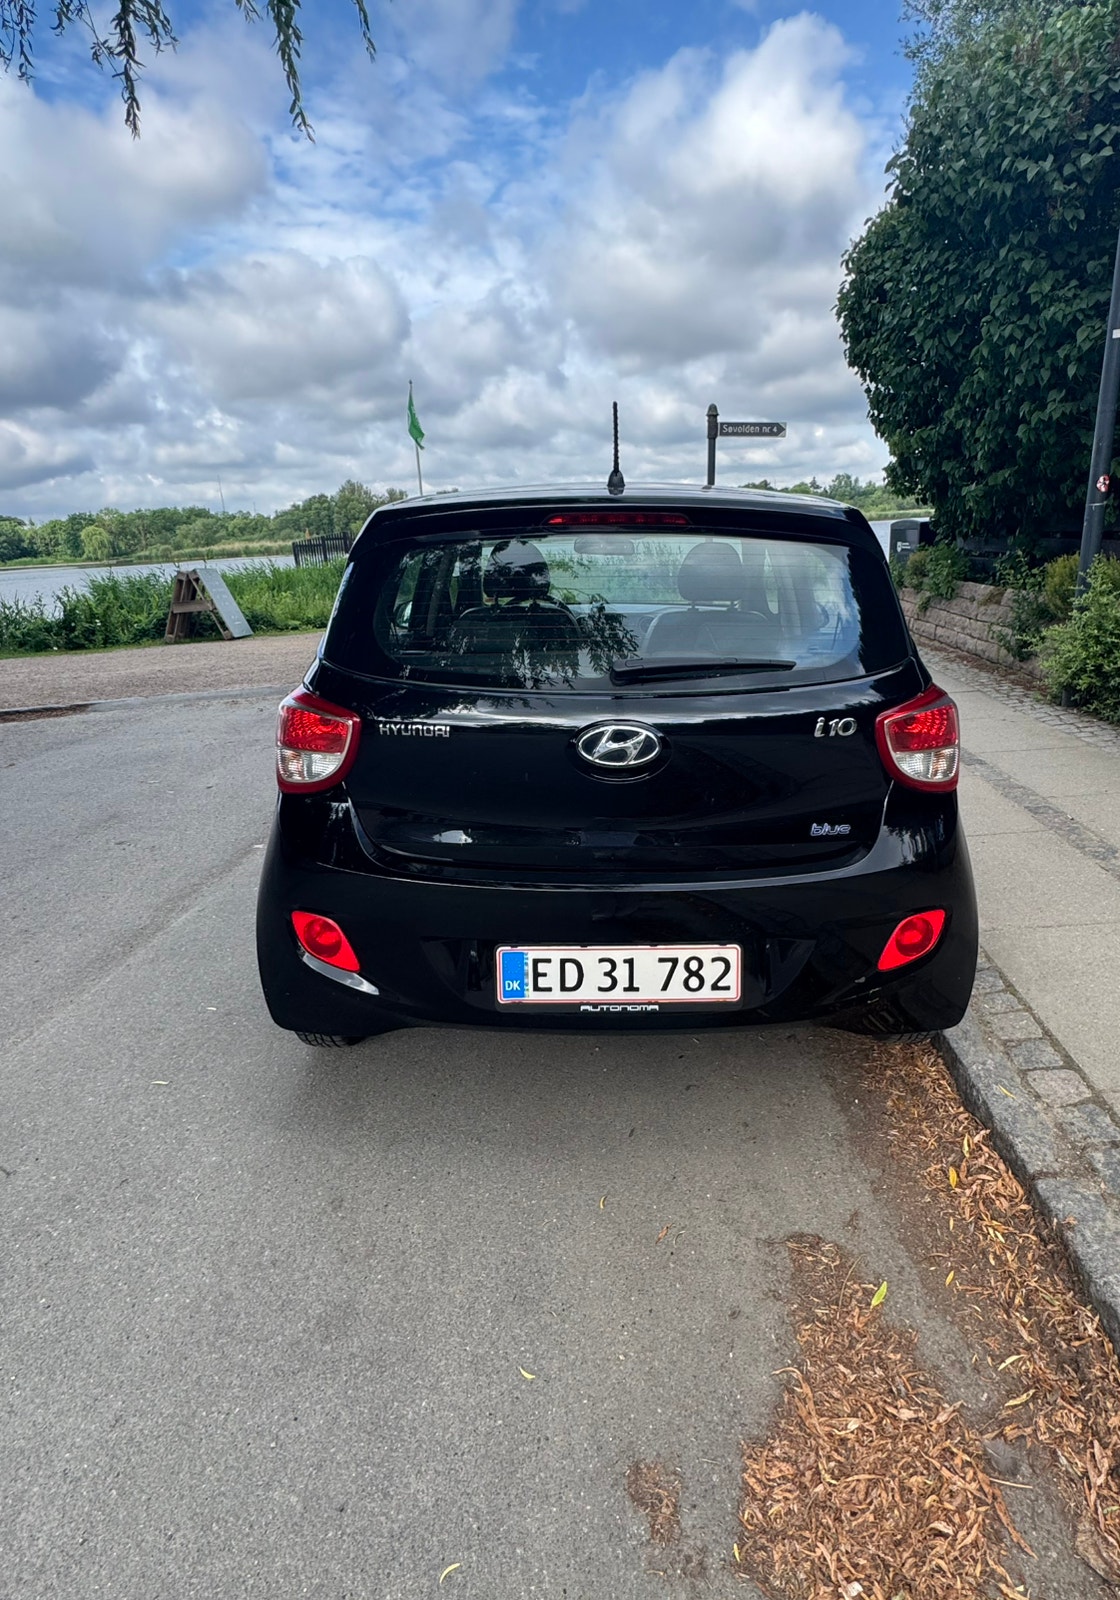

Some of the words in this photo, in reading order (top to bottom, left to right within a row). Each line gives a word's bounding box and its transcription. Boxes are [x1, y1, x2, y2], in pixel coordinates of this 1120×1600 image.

[772, 425, 778, 433] 4
[379, 723, 450, 738] HYUNDAI
[814, 717, 857, 738] i10
[810, 822, 851, 837] blue
[532, 958, 584, 992] ED
[597, 957, 640, 992] 31
[657, 956, 731, 992] 782
[505, 980, 521, 991] DK
